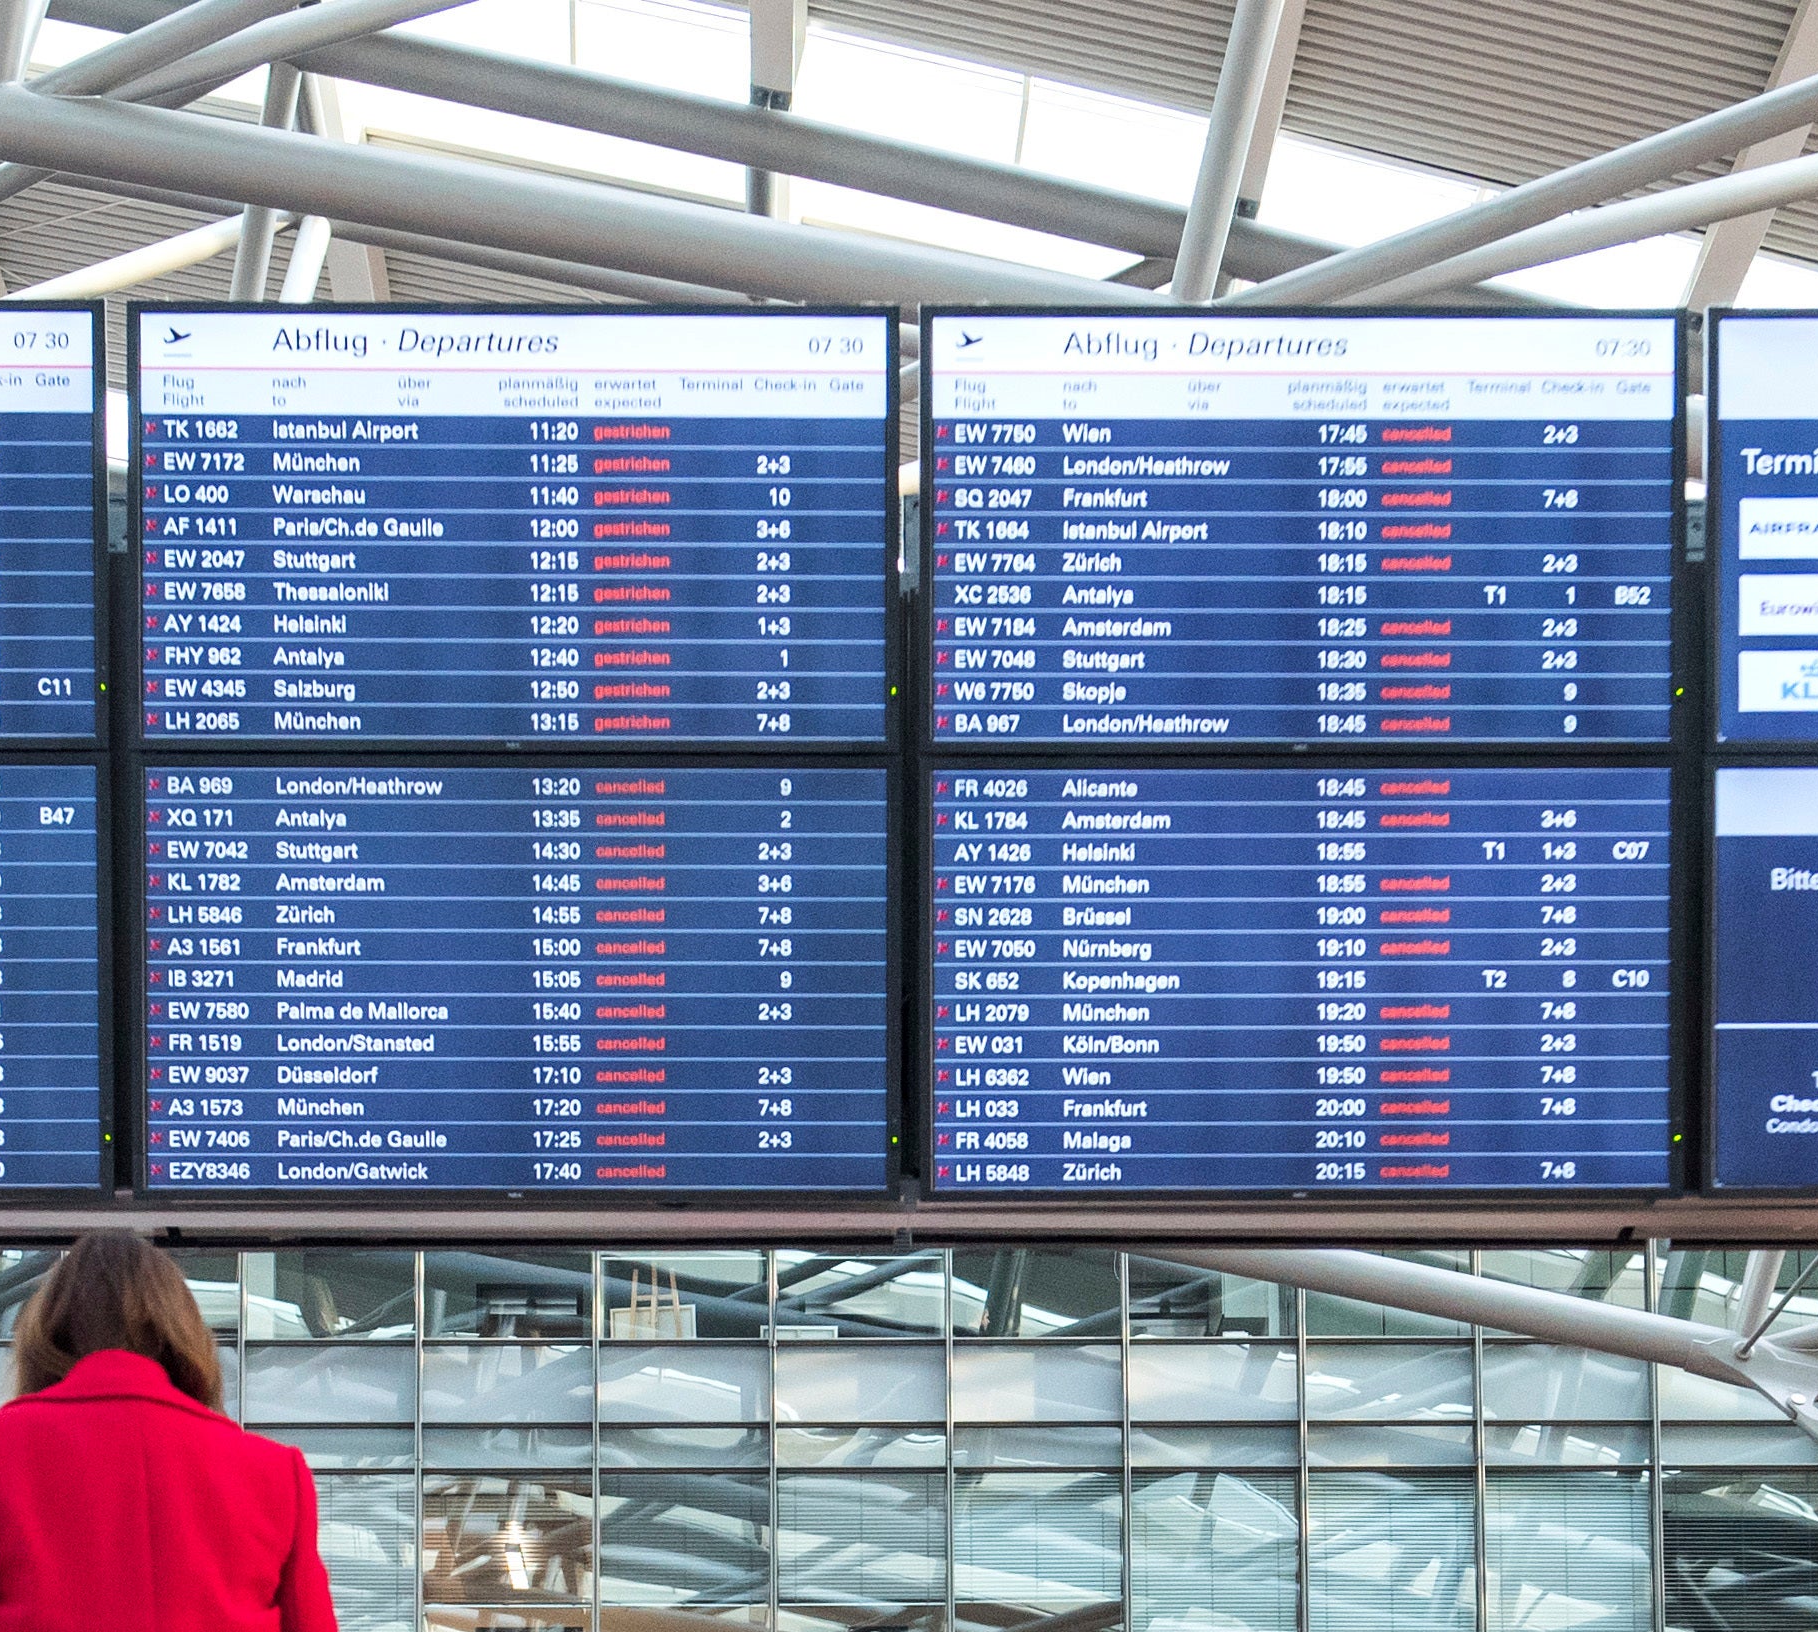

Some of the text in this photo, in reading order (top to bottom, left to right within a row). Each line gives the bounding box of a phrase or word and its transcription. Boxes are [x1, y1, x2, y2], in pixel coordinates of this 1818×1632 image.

[1064, 333, 1346, 360] Abflug Departures
[36, 374, 70, 386] Gate
[164, 485, 790, 506] LO 400 Warschau 11:40 10
[38, 678, 71, 695] C11
[168, 776, 791, 796] BA 969 London/Heathrow 13:20 9
[40, 807, 74, 824] B47
[955, 972, 981, 989] SK
[986, 972, 1019, 989] 652
[1063, 972, 1179, 993] Kopenhagen
[1317, 971, 1366, 988] 19:15
[1482, 970, 1506, 988] T2
[1612, 969, 1649, 987] C10
[169, 1066, 791, 1084] EW 9037 Düsseldorf 17:10 2+3
